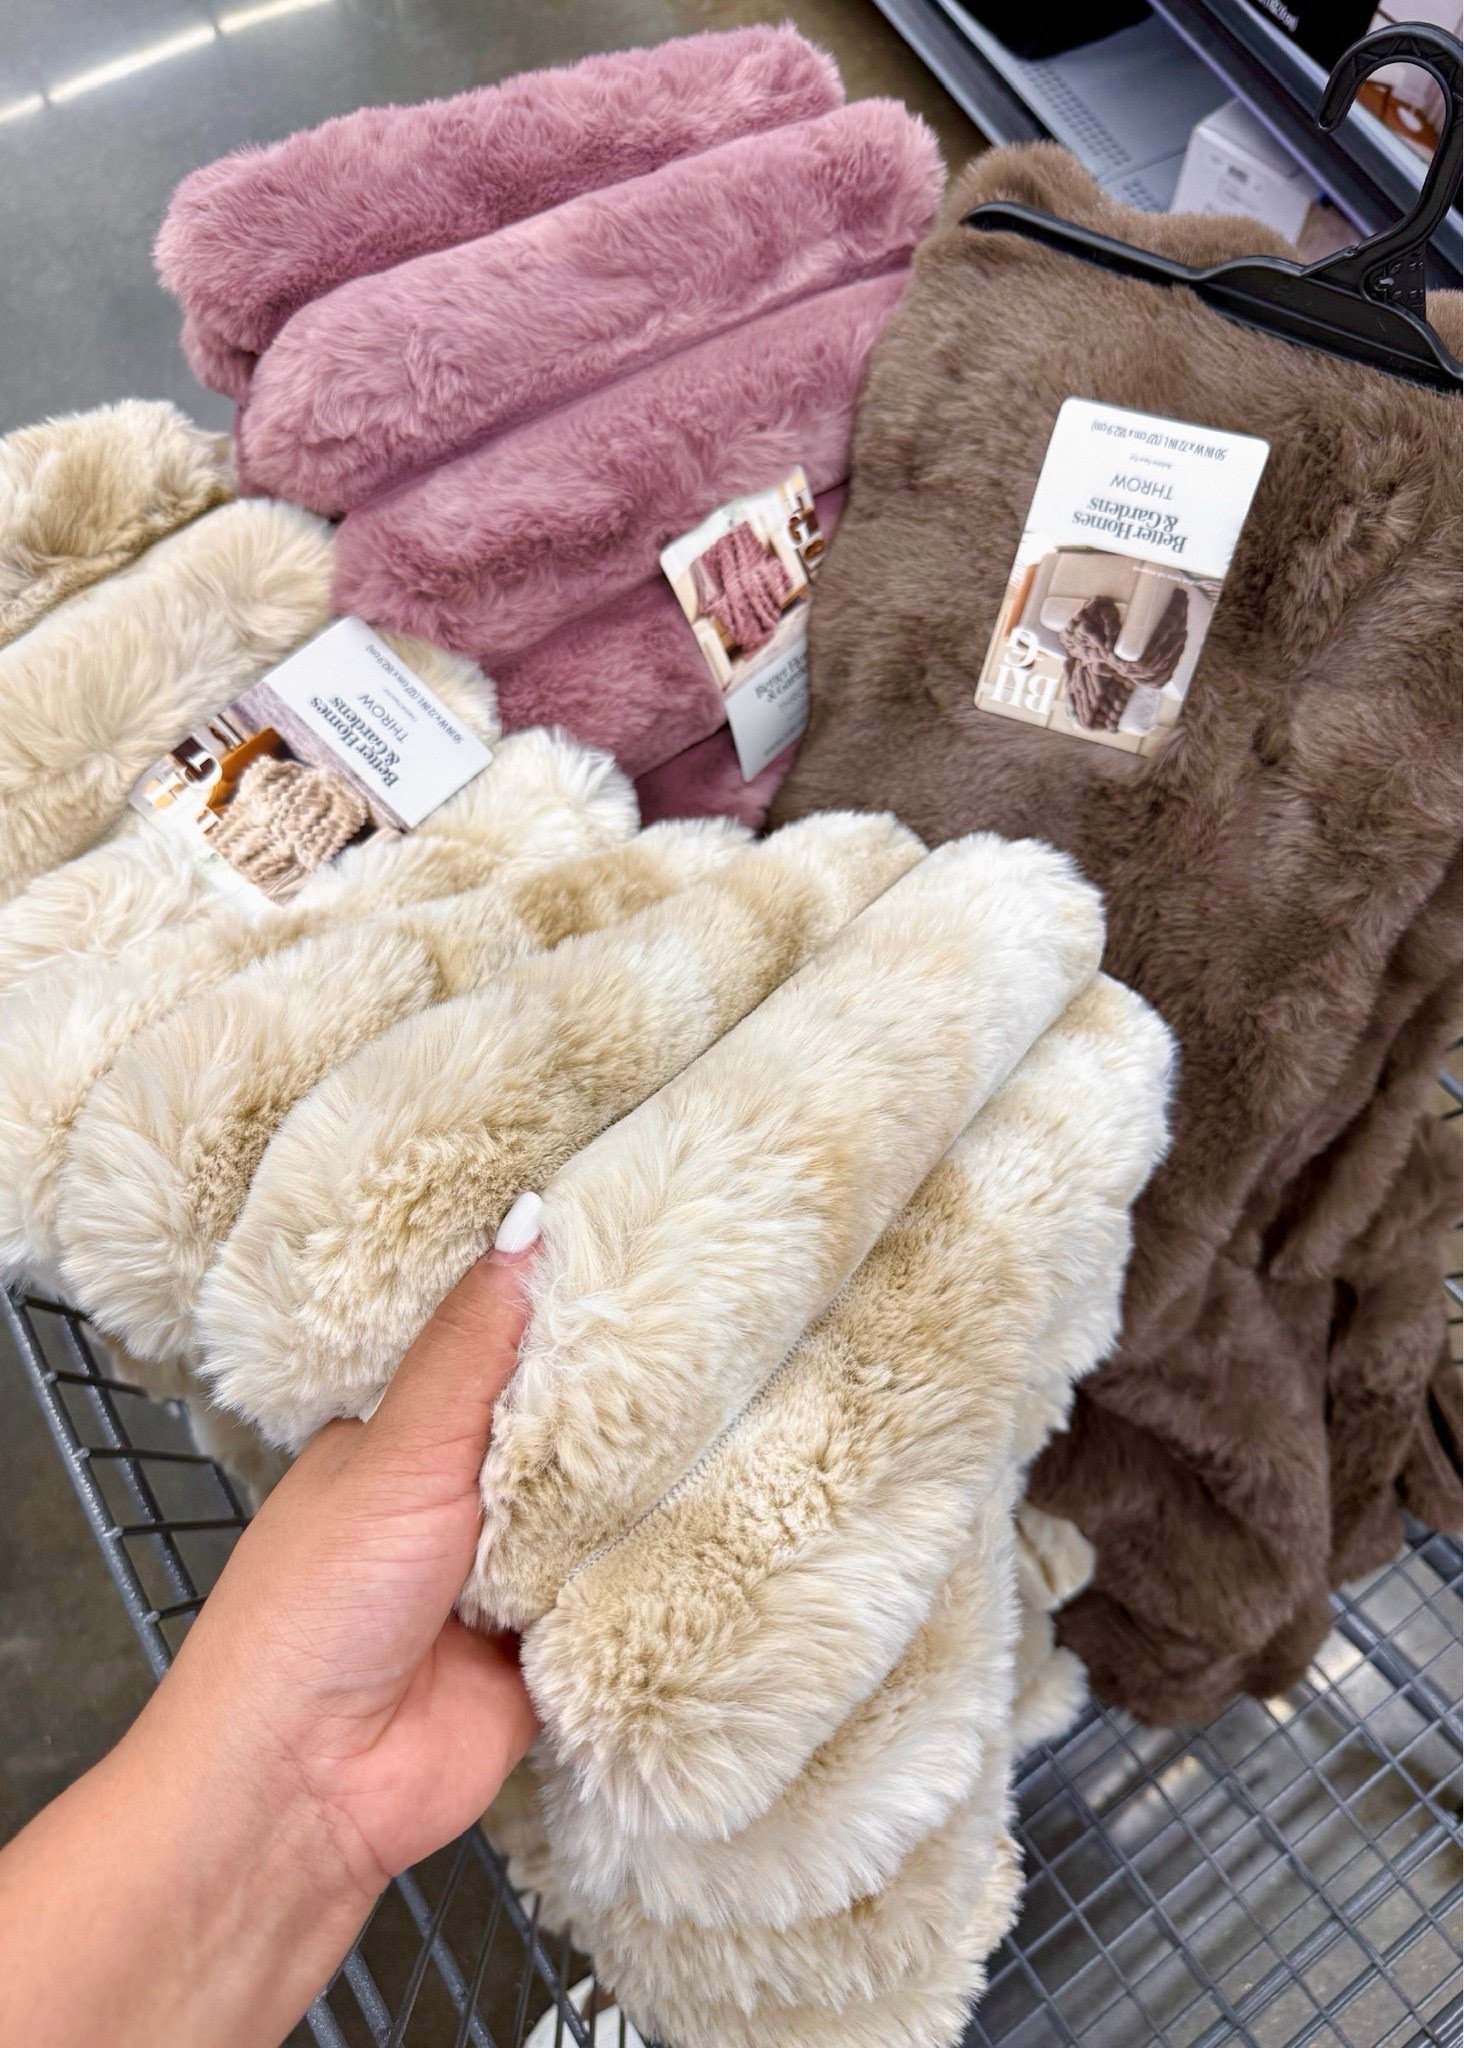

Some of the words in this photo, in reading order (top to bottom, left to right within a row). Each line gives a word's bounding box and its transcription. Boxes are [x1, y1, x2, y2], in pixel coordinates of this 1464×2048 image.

[1111, 474, 1173, 500] THROW
[1072, 512, 1132, 537] Homes
[1089, 498, 1162, 528] Gardens
[1162, 514, 1179, 534] &
[1132, 527, 1187, 553] Better
[310, 697, 359, 748] Homes
[330, 697, 390, 757] Gardens
[359, 693, 408, 743] THROW
[354, 742, 398, 787] Better
[383, 751, 401, 768] &
